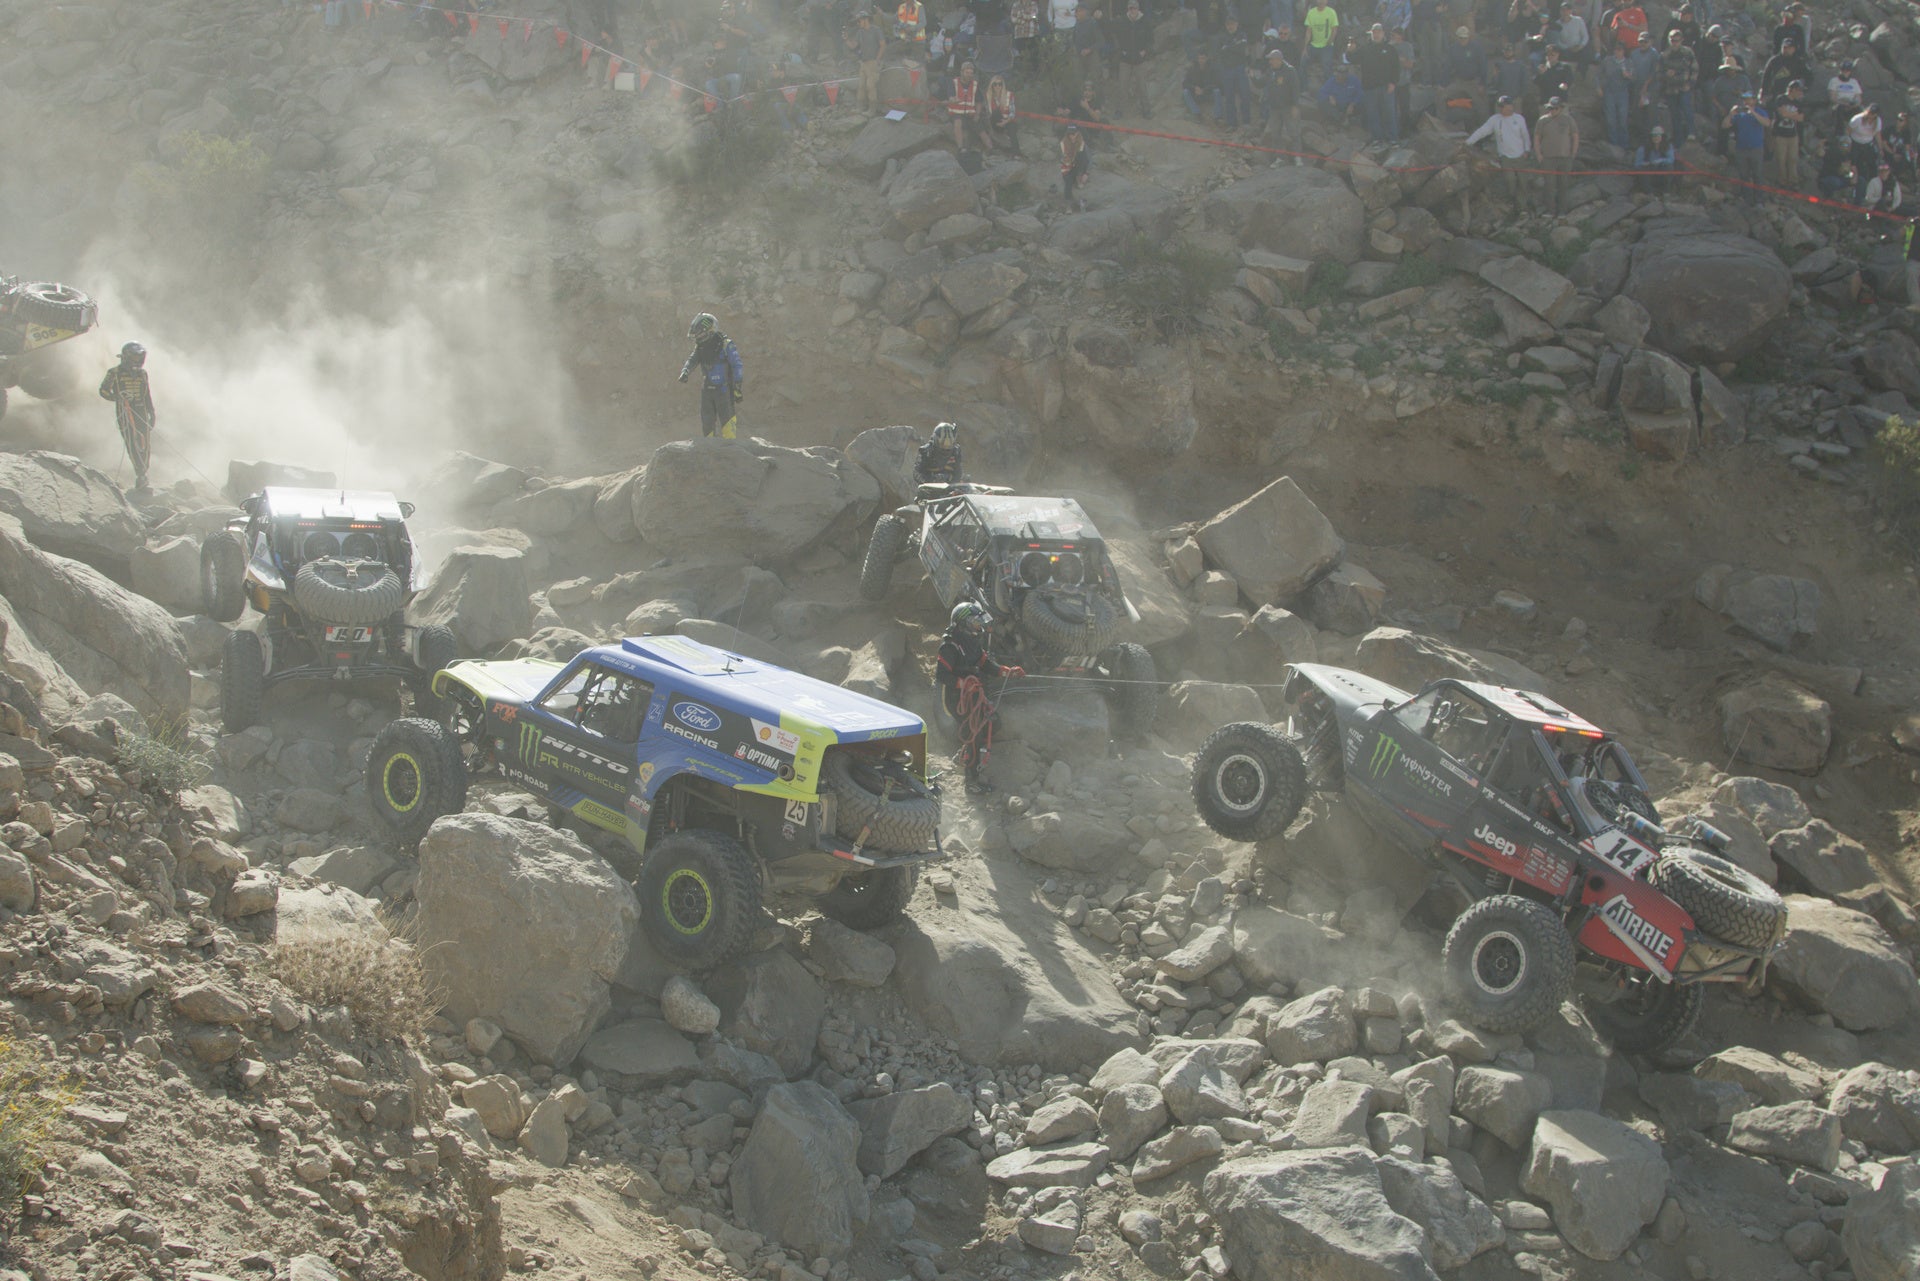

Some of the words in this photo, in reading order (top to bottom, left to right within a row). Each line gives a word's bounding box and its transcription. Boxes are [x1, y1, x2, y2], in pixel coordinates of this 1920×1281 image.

[681, 705, 713, 728] Ford
[663, 722, 719, 749] RACING
[541, 735, 630, 774] NITTO
[746, 748, 780, 771] OPTIMA
[523, 773, 549, 792] ROADS
[582, 769, 627, 794] VEHICLES
[1400, 753, 1452, 797] MONSTER
[787, 801, 805, 822] 25
[1474, 824, 1517, 856] Jeep
[1604, 837, 1643, 870] 14
[1602, 893, 1674, 958] CURRIE
